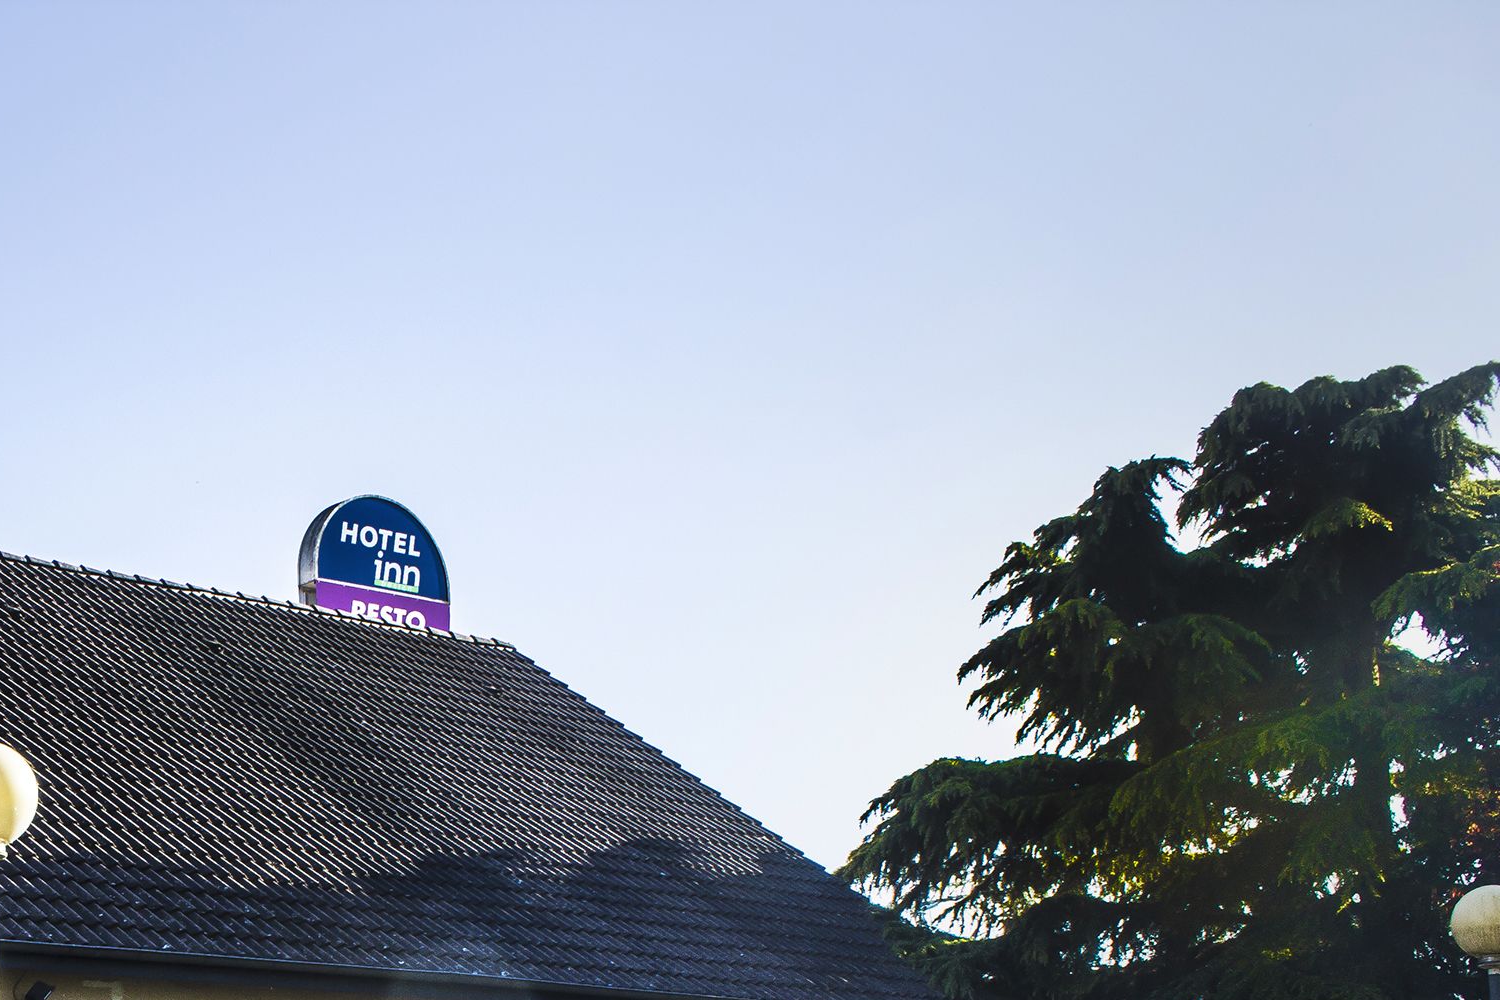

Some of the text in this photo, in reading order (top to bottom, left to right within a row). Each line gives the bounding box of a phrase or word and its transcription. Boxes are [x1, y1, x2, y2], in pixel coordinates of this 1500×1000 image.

[340, 521, 421, 557] HOTEL
[374, 551, 421, 587] inn
[351, 600, 426, 629] RESTO
